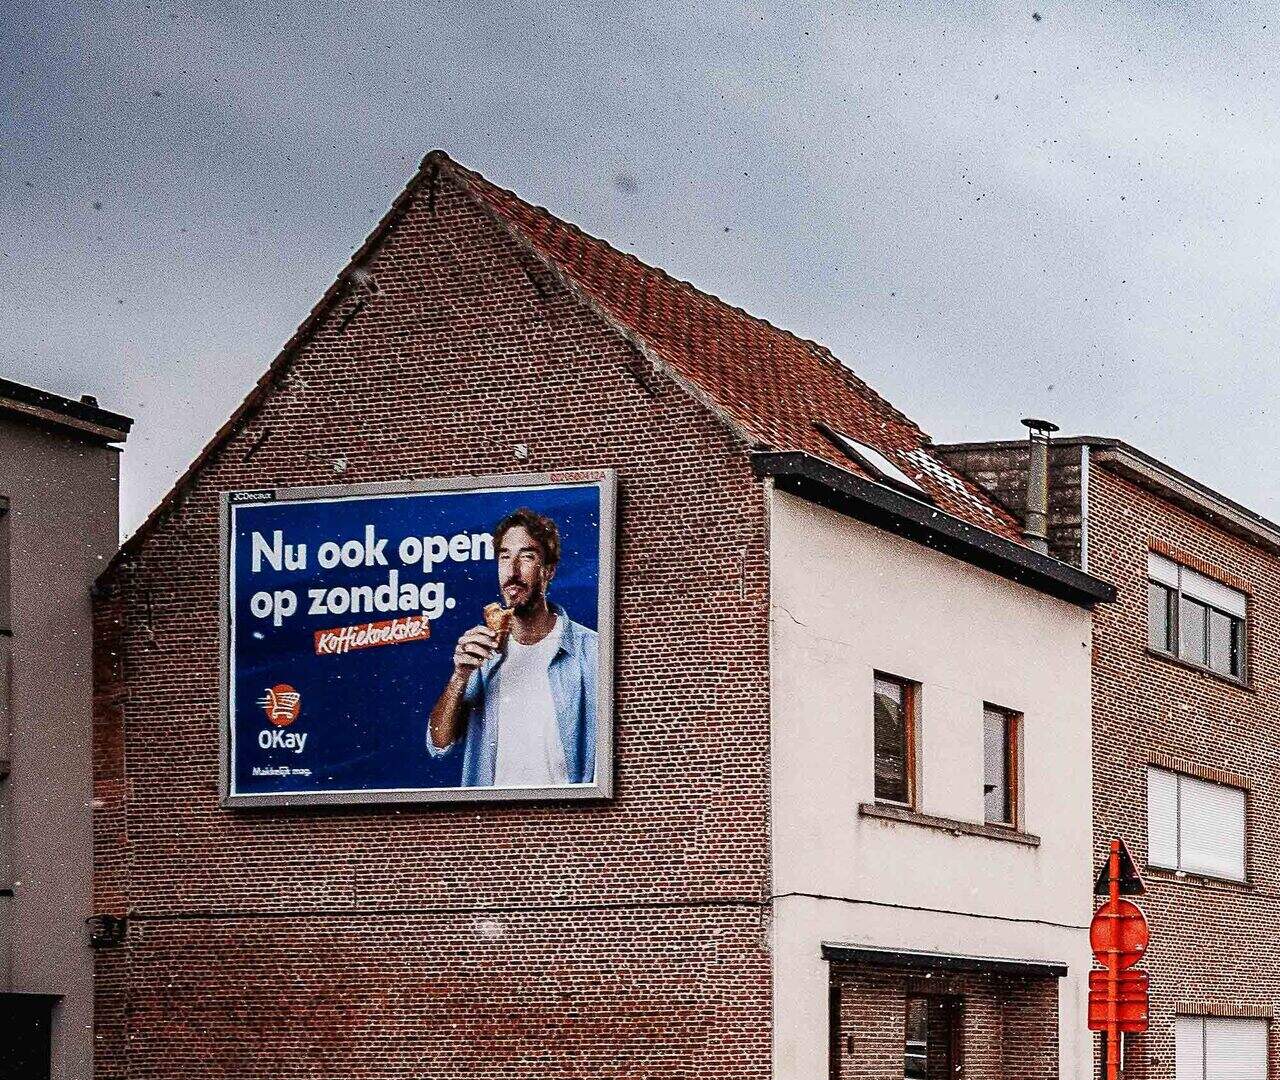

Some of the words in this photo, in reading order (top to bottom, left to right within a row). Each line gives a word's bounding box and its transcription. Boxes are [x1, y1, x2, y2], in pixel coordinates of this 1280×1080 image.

[251, 530, 307, 572] Nu
[318, 525, 389, 569] ook
[399, 532, 495, 573] open
[250, 589, 298, 626] op
[308, 569, 456, 620] zondag.
[258, 729, 308, 754] OKay
